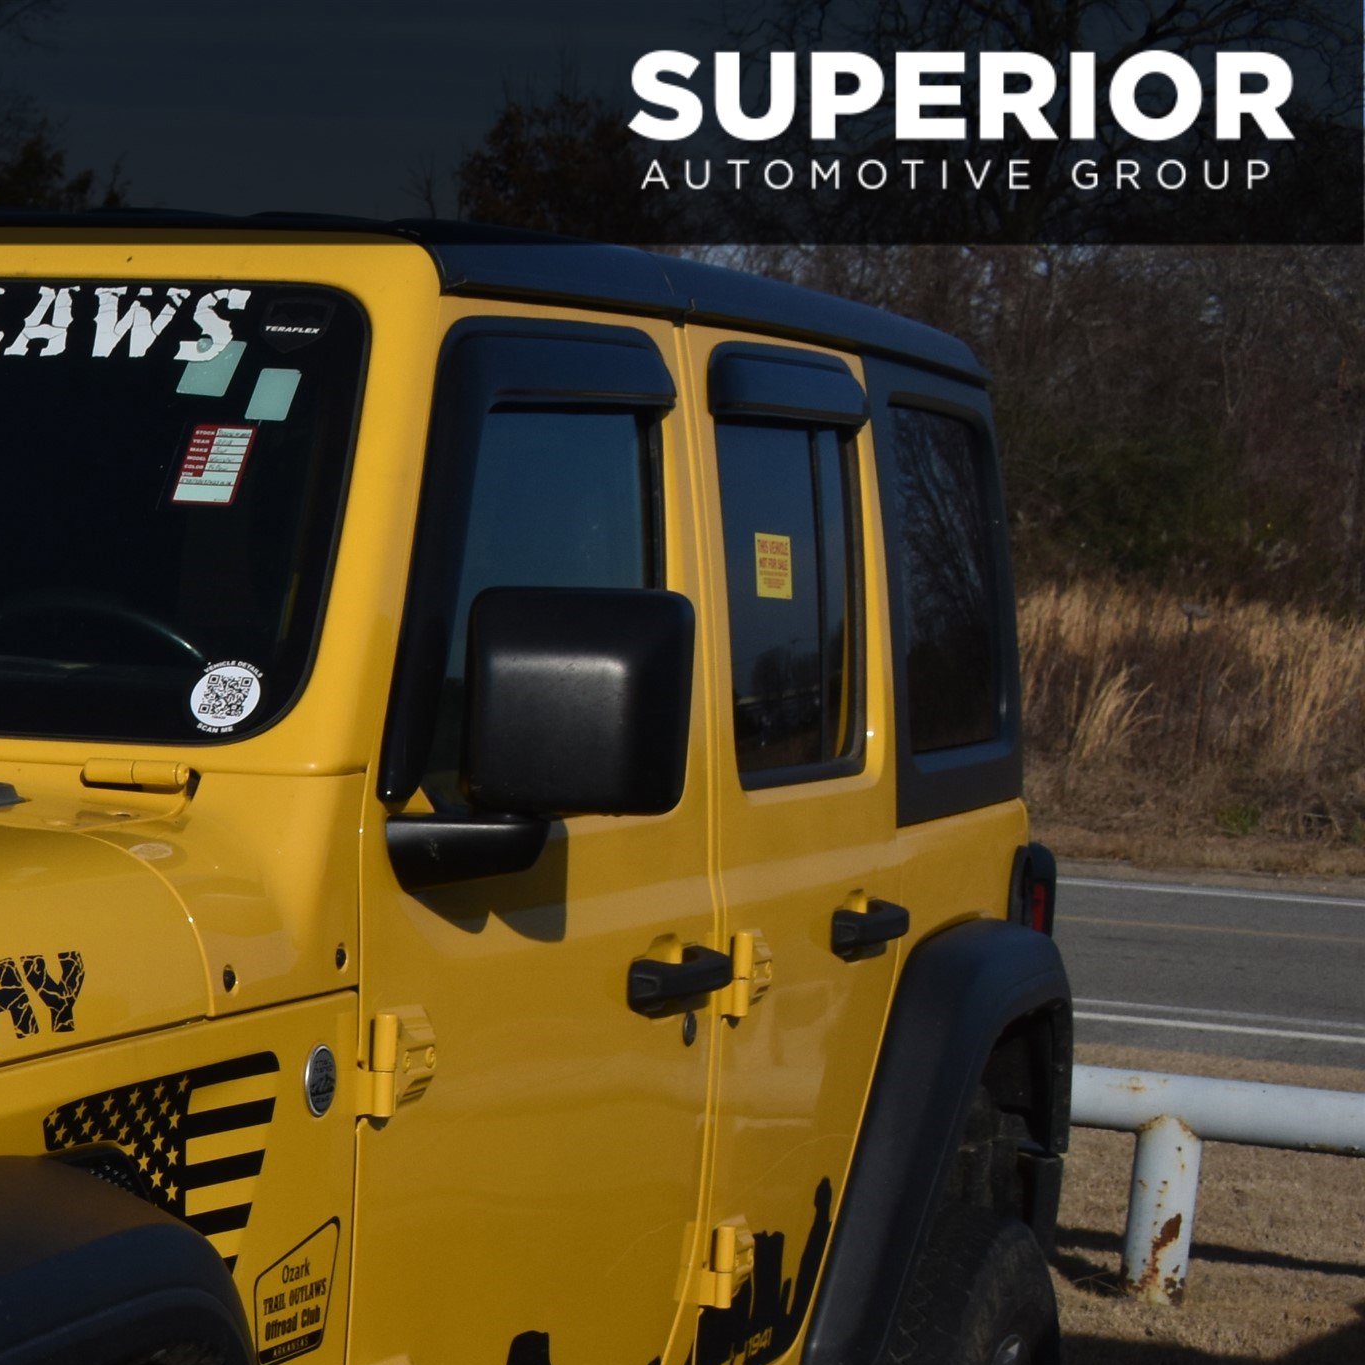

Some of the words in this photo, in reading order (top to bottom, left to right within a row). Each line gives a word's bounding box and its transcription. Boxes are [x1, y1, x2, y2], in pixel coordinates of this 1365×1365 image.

[265, 324, 323, 336] TERAFLEX
[203, 660, 236, 674] VEHICLE
[237, 661, 264, 679] DETAILS
[196, 722, 219, 733] SCAN
[282, 1257, 310, 1284] Ozark
[263, 1292, 286, 1316] TRAIL
[289, 1278, 327, 1306] OUTLAWS
[265, 1312, 298, 1341] Offroad
[301, 1304, 321, 1328] Club
[273, 1337, 309, 1358] ARKANSAS
[748, 1326, 773, 1358] 1941
